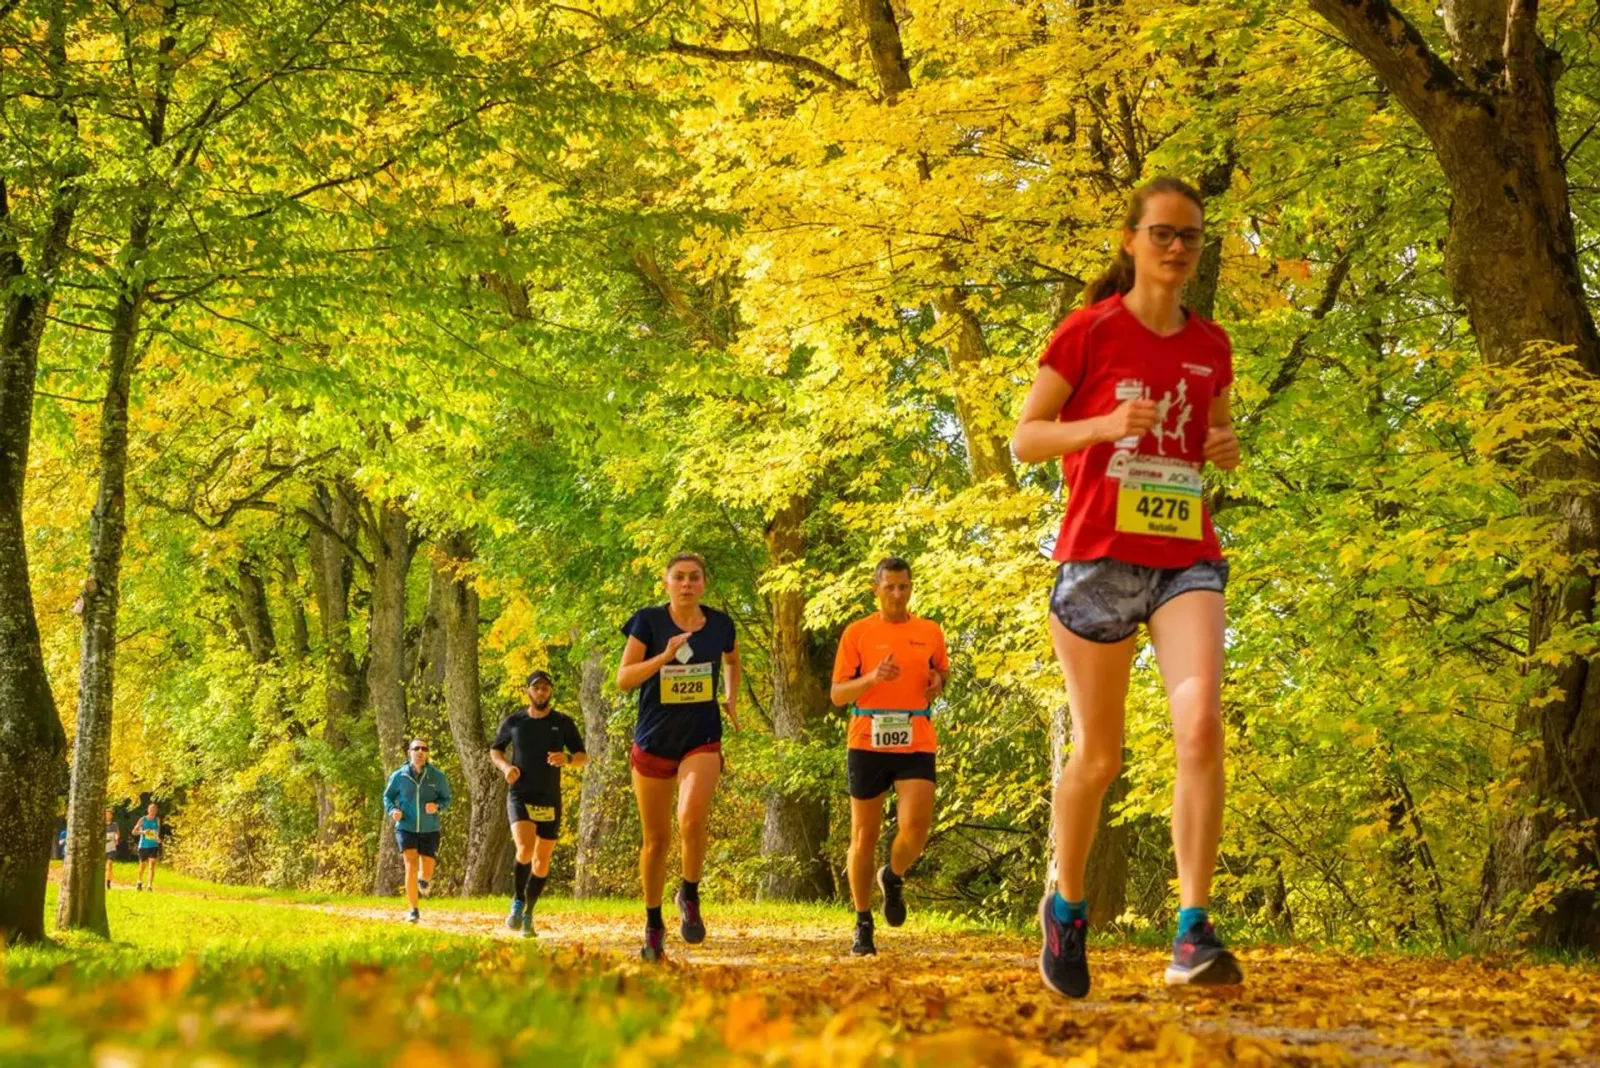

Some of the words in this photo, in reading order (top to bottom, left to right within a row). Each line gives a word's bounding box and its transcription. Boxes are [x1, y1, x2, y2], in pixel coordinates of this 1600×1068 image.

[1136, 496, 1189, 520] 4276
[672, 681, 703, 694] 4228
[875, 731, 908, 746] 1092
